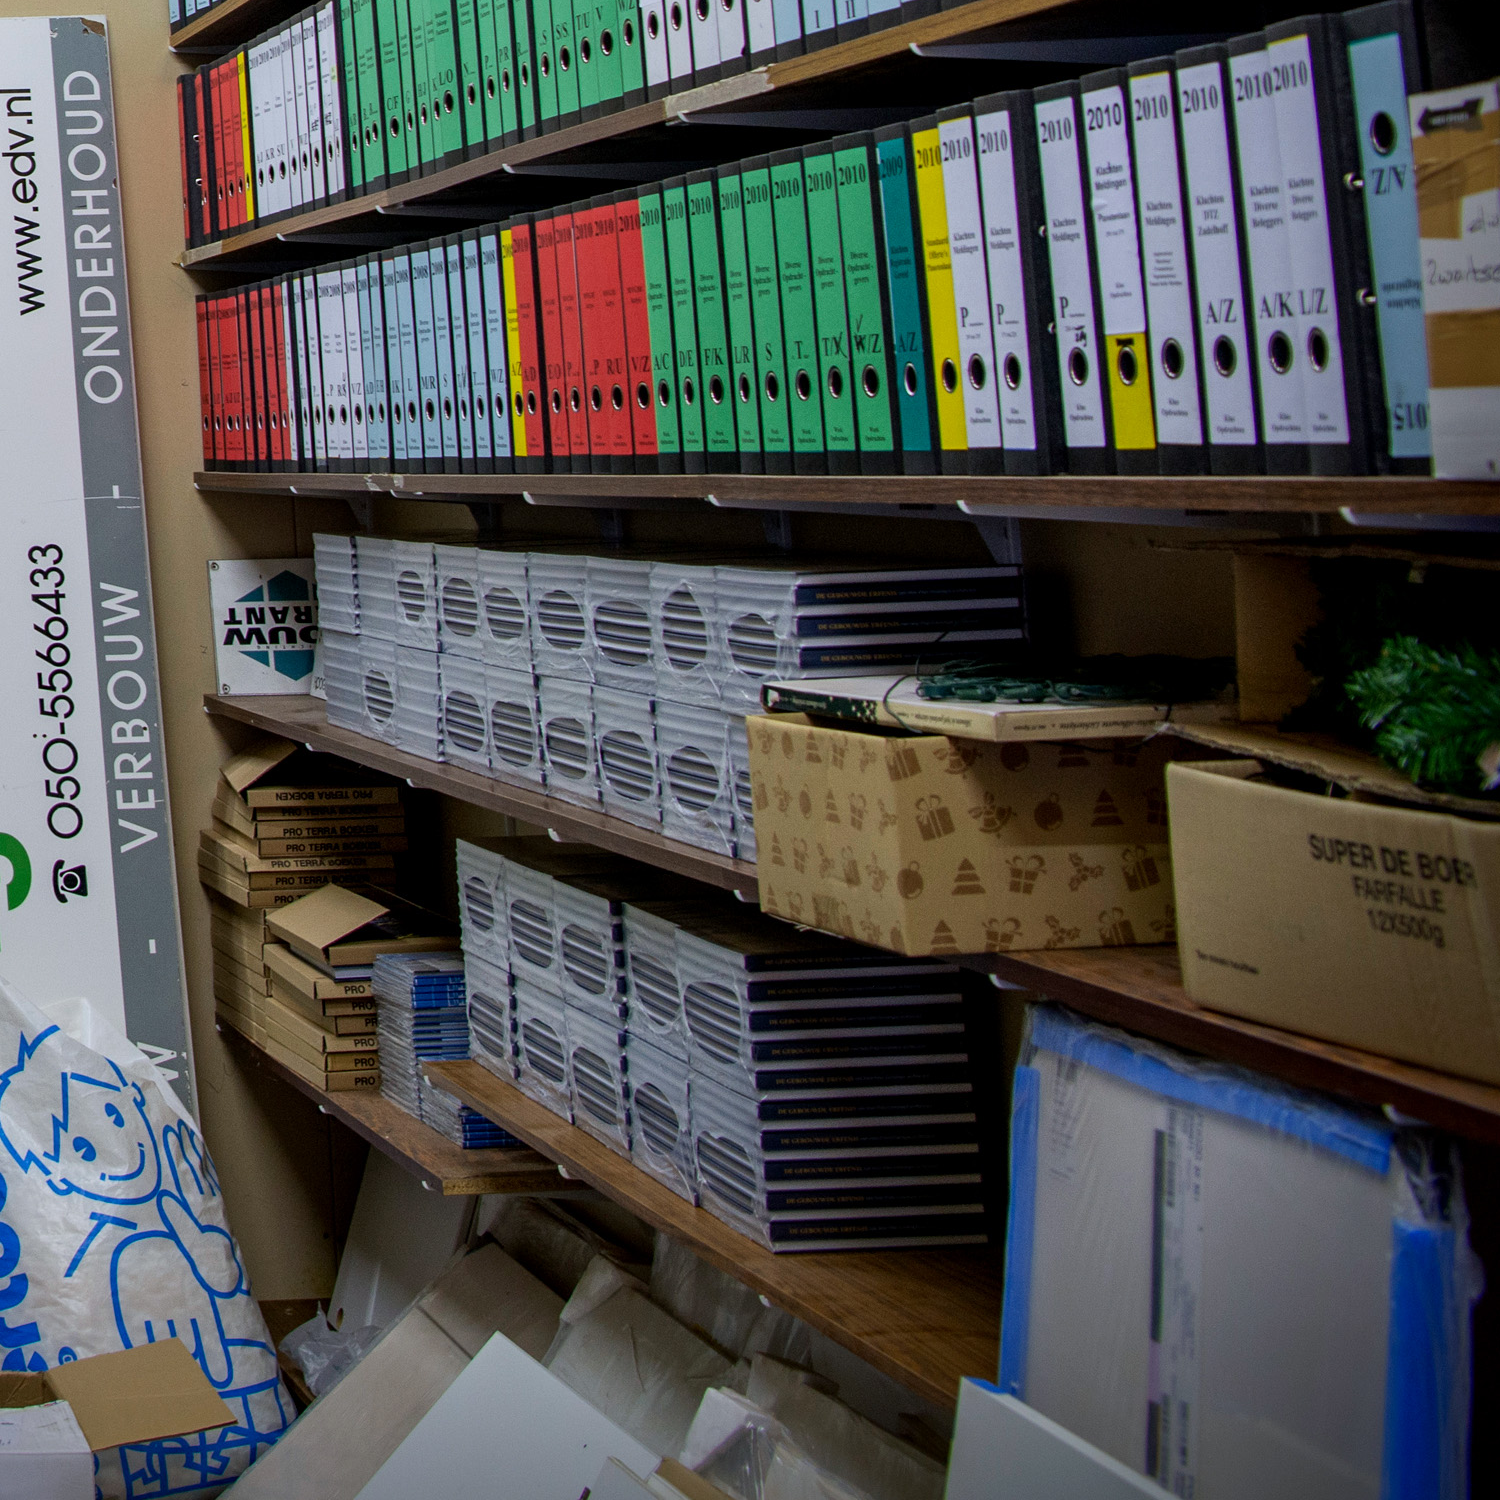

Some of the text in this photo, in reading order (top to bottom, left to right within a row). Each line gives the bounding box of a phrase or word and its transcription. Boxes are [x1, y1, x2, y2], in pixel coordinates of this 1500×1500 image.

[1235, 70, 1273, 102] 2010
[1273, 59, 1308, 92] 2010
[1135, 94, 1169, 122] 2010
[1183, 84, 1219, 114] 2010
[1040, 116, 1073, 144] 2010
[1087, 102, 1122, 132] 2010
[942, 136, 971, 162] 2010
[980, 128, 1008, 154] 2010
[916, 144, 942, 170] 2010
[807, 171, 833, 193] 2010
[838, 162, 866, 187] 2010
[720, 190, 740, 211] 2010
[745, 183, 768, 206] 2010
[774, 177, 799, 200] 2010
[641, 207, 660, 227] 2010
[665, 201, 684, 222] 2010
[690, 195, 711, 216] 2010
[1205, 298, 1238, 325] A/Z
[1259, 290, 1294, 320] A/K
[1299, 286, 1329, 316] L/Z
[703, 347, 724, 366] F/K
[63, 70, 159, 854] VERBOUW ONDERHOUD
[223, 605, 314, 625] RANT
[222, 626, 319, 646] OUW
[27, 542, 84, 839] 050-5566433
[1308, 833, 1479, 889] SUPER DE BOER
[1352, 875, 1447, 914] FARFALLE
[344, 986, 366, 995] PRO
[354, 1038, 375, 1047] PRO
[354, 1058, 375, 1067] PRO
[354, 1077, 376, 1086] PRO
